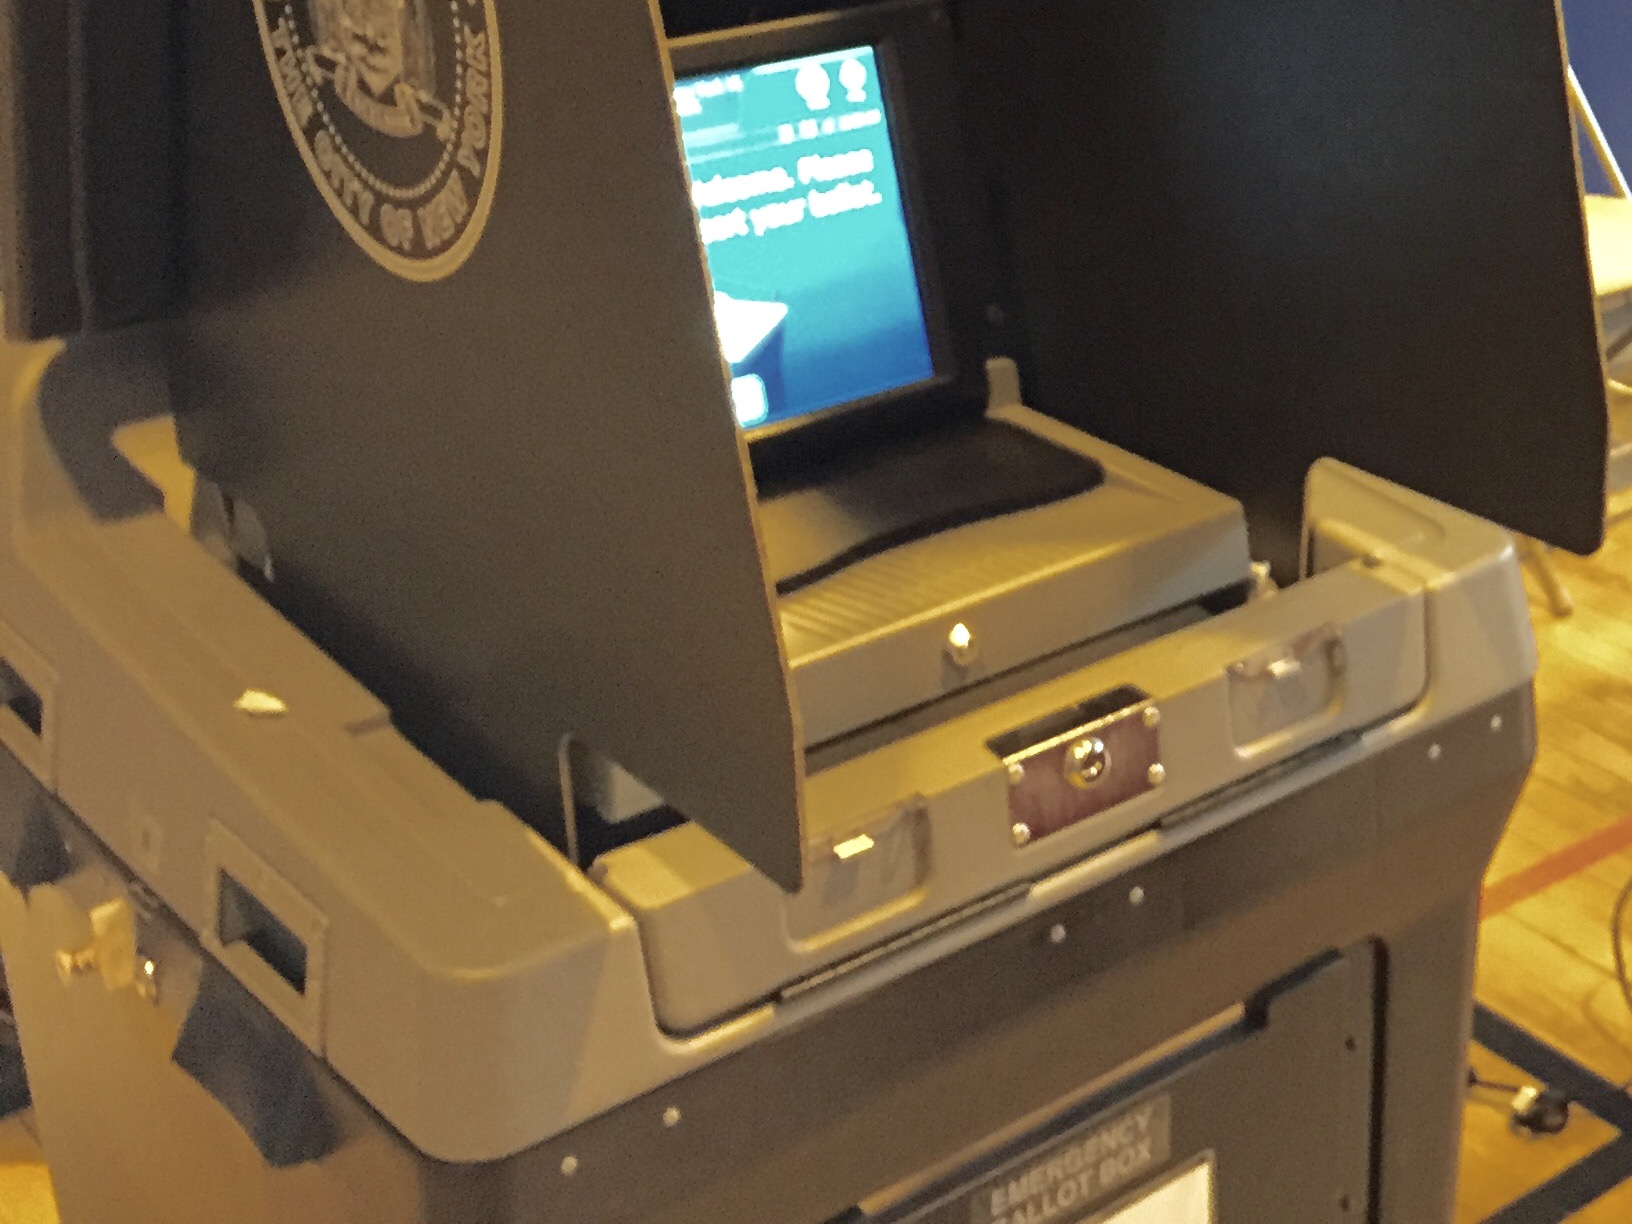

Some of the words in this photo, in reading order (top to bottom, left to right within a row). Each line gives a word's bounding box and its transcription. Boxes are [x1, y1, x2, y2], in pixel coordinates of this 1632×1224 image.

[457, 25, 488, 178] YORK
[990, 1104, 1154, 1217] EMERGENCY
[991, 1168, 1094, 1224] ALLOT
[1099, 1137, 1153, 1187] BOX
